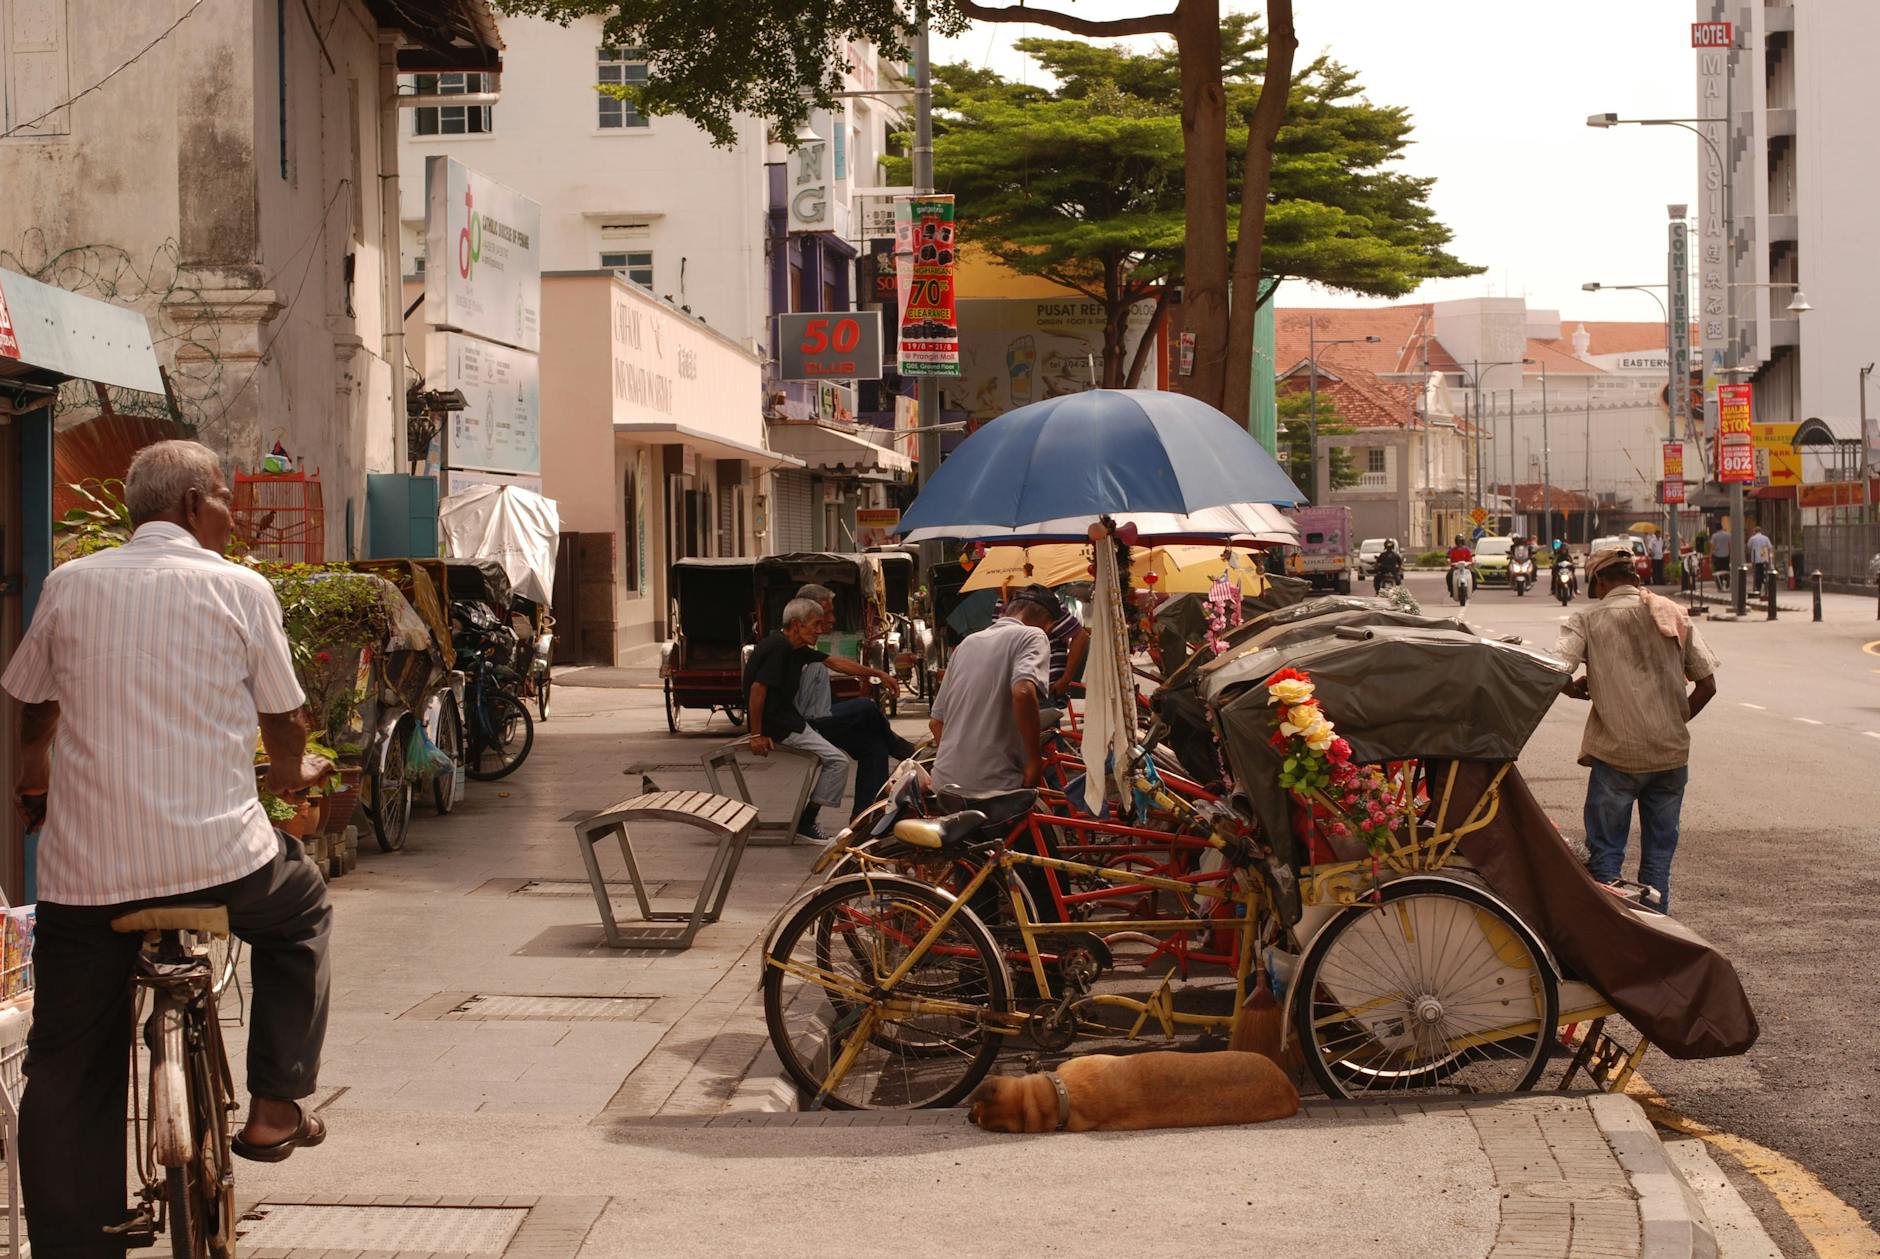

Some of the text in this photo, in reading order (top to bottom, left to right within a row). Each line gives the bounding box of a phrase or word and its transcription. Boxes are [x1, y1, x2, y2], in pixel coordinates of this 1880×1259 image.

[1694, 25, 1729, 45] HOTEL
[1702, 54, 1723, 238] MALAYSIA
[792, 142, 827, 223] NG
[1673, 225, 1686, 375] CONTINENTAL
[907, 309, 951, 319] CLEARANCE
[1037, 304, 1077, 317] PUSAT
[800, 318, 861, 355] 50
[803, 361, 856, 375] CLUB
[1623, 359, 1671, 367] EASTERN
[1721, 419, 1751, 433] STOK
